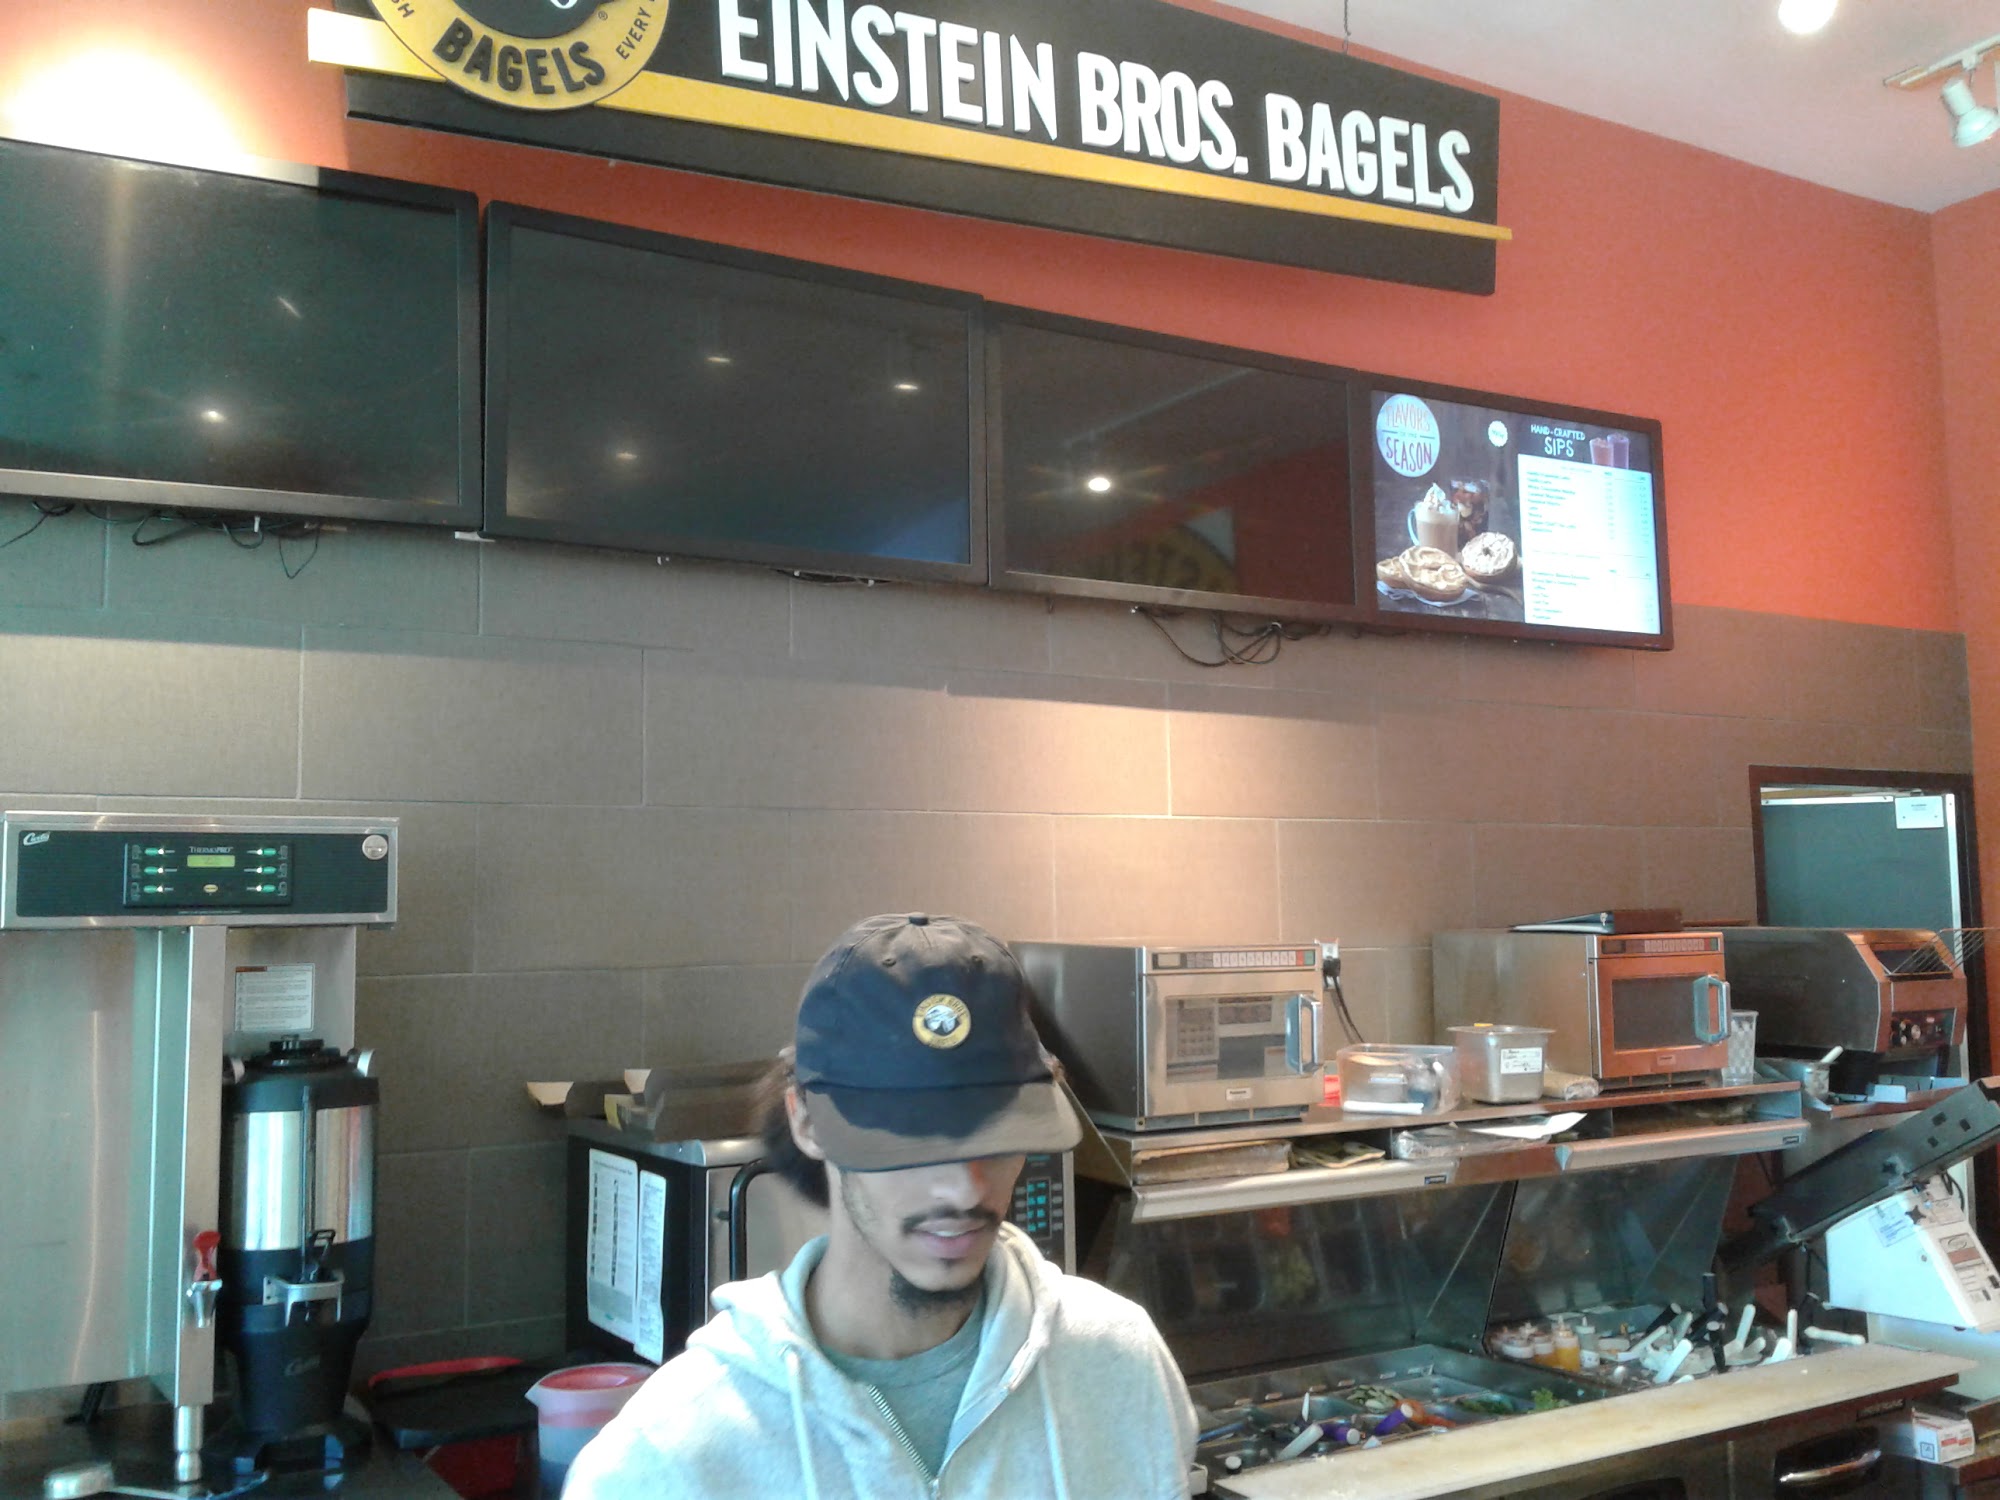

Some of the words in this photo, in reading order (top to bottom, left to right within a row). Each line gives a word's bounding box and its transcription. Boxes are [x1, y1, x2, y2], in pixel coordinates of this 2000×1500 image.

[615, 6, 652, 60] EVERY
[432, 17, 606, 95] BAGELS
[719, 0, 1058, 142] EINSTEIN
[1077, 51, 1249, 175] BROS.
[1265, 93, 1474, 214] BAGELS
[1385, 402, 1431, 432] FLAVORS
[1386, 436, 1432, 472] SEASON
[1544, 436, 1574, 457] SIPS
